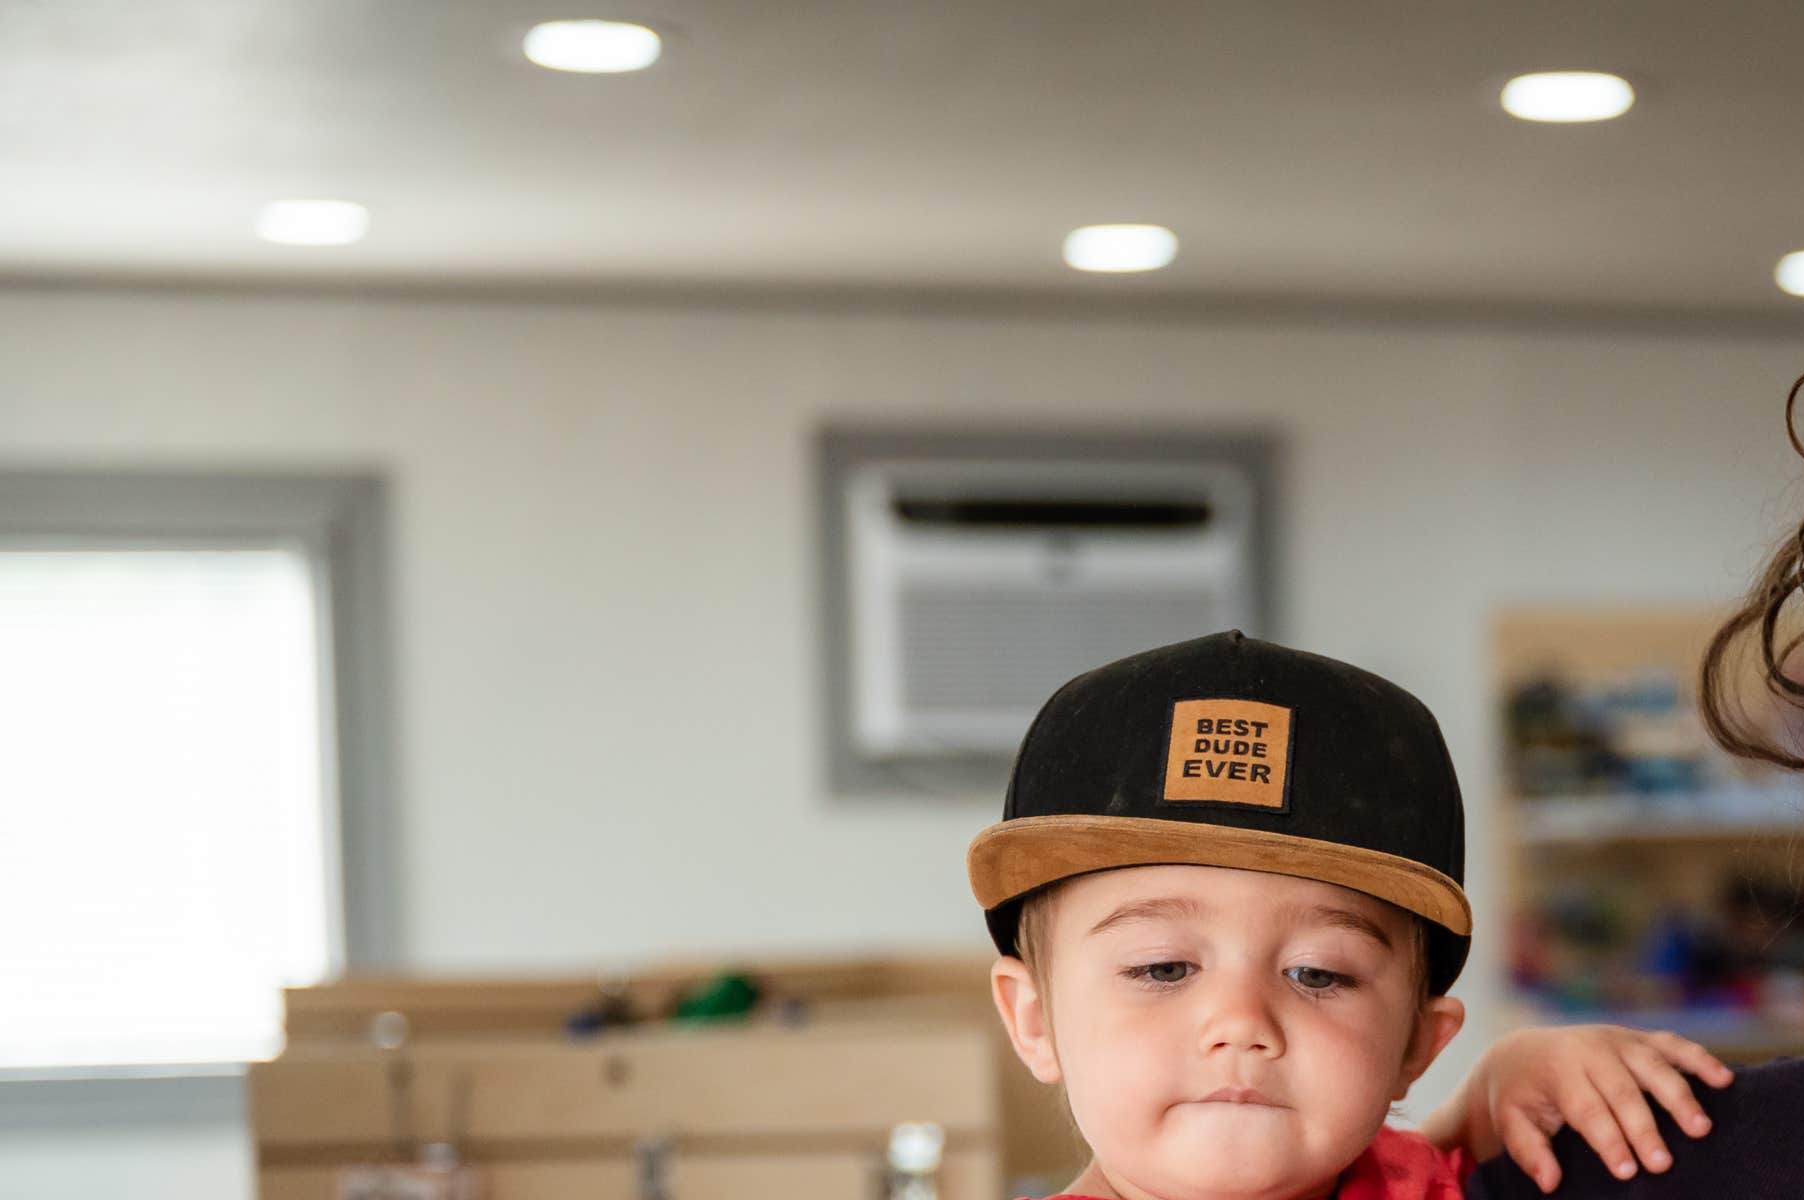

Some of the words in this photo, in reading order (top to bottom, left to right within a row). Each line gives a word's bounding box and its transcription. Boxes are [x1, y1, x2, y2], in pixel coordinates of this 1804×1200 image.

[1196, 718, 1269, 738] BEST
[1194, 738, 1268, 758] DUDE
[1182, 759, 1271, 784] EVER
